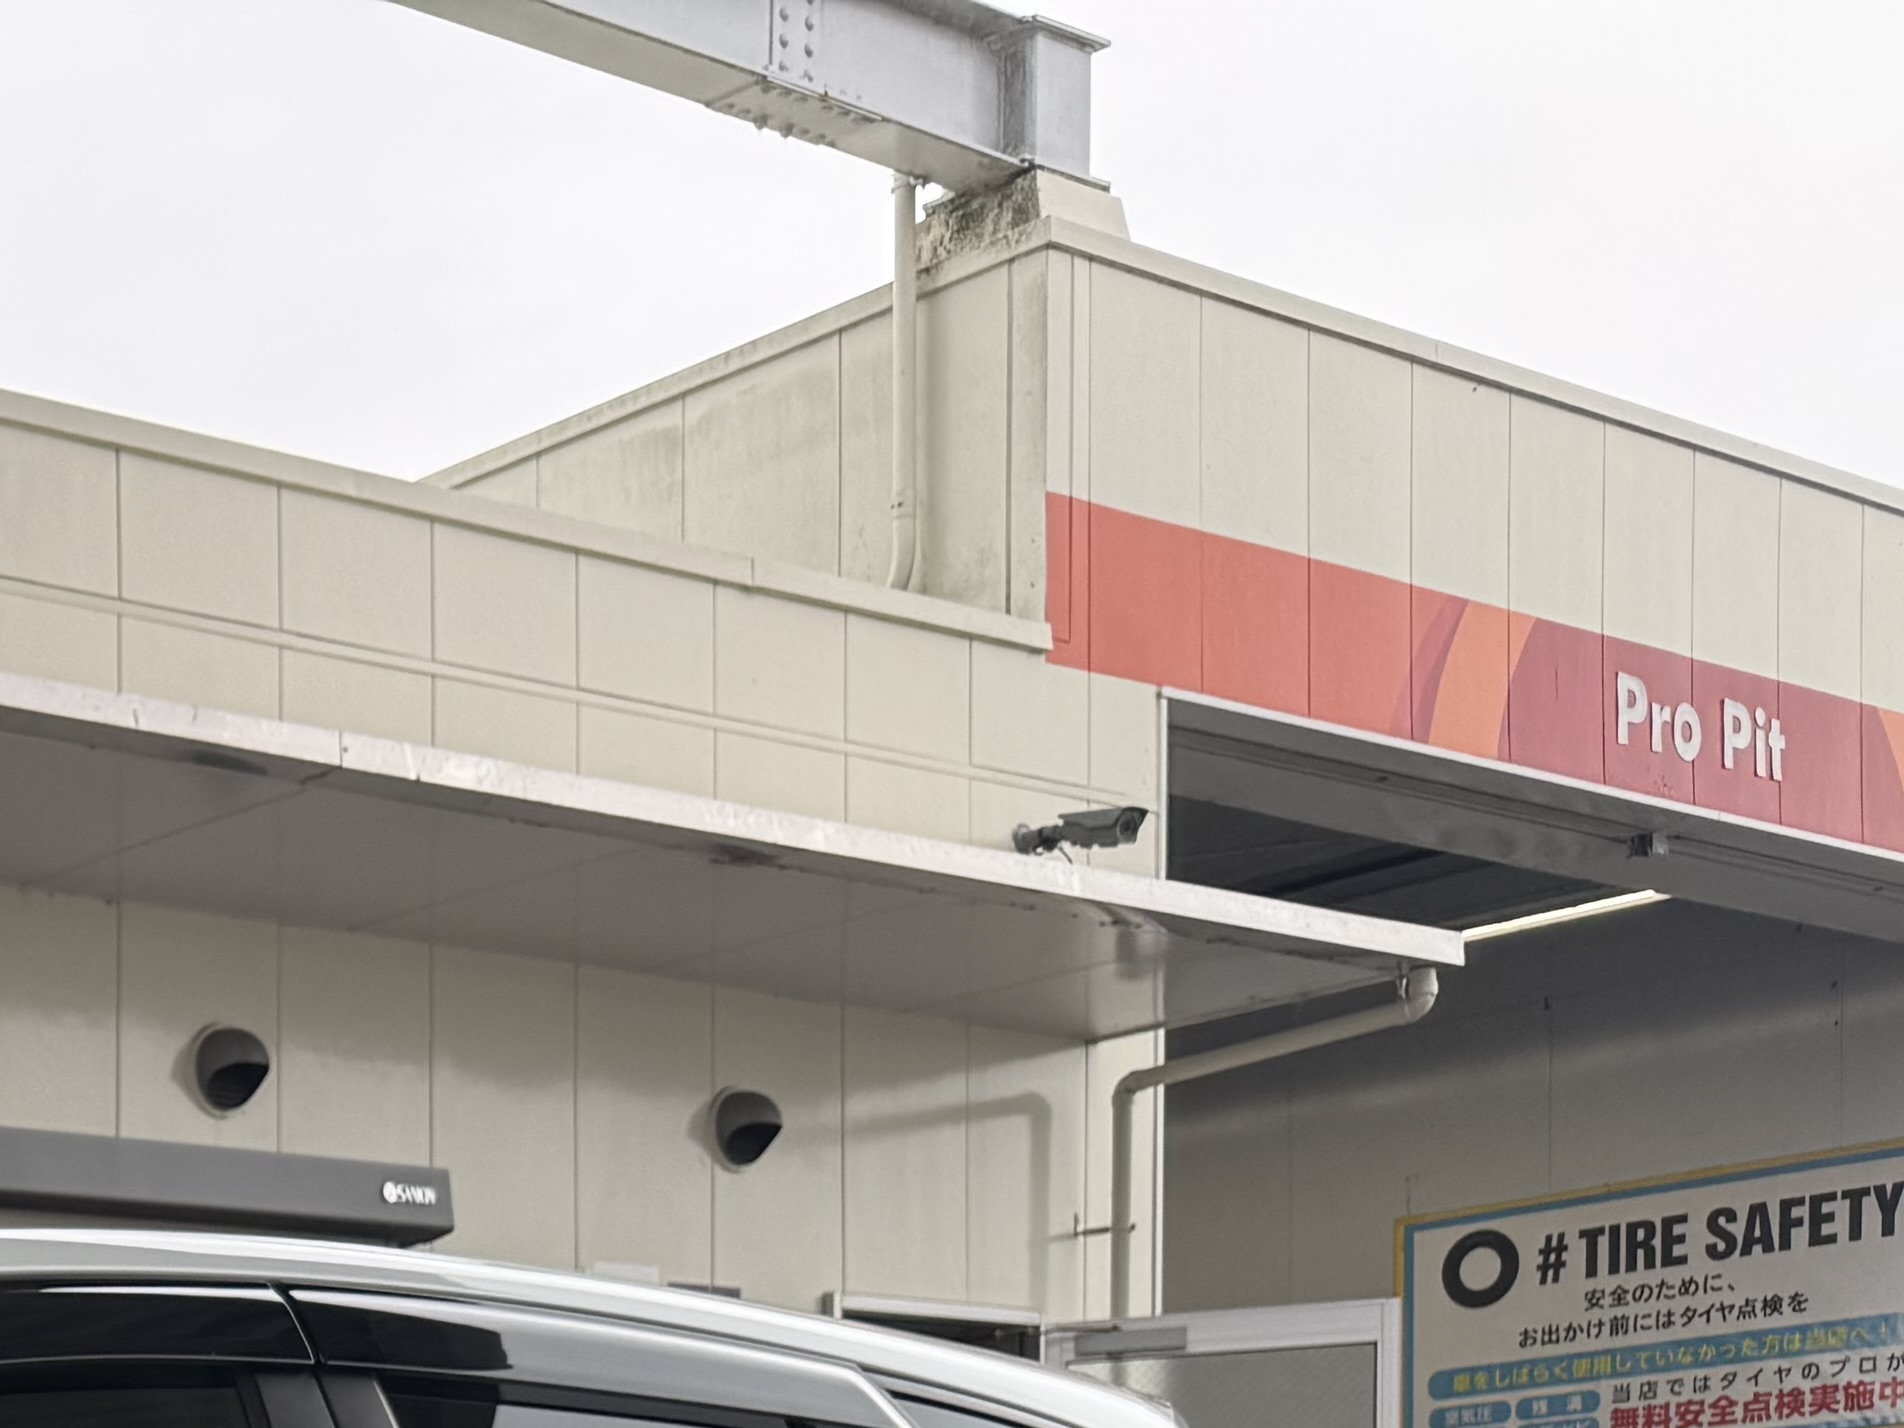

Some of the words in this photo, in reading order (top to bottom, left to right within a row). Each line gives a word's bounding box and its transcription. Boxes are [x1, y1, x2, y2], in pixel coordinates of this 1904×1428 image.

[1616, 670, 1702, 763] Pro
[1722, 697, 1786, 782] Pit
[1704, 1181, 1904, 1263] SAFETY
[1518, 1291, 1809, 1348] お出かけ前にはタイヤ点検を
[1583, 1273, 1735, 1312] 安全のために、
